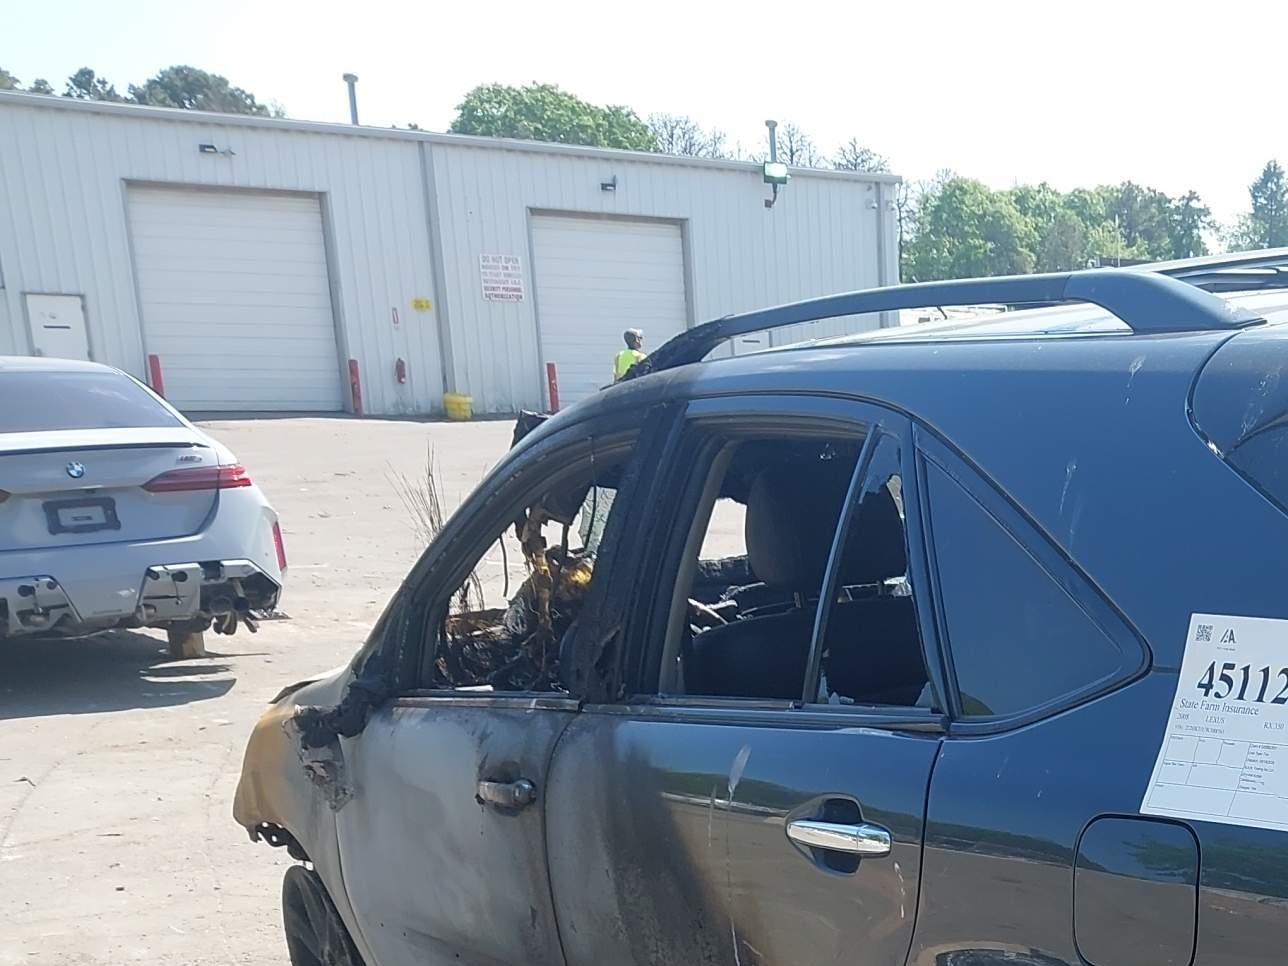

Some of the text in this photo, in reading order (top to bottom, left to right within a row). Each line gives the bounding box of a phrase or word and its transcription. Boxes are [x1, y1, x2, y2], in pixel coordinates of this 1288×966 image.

[1180, 698, 1259, 716] State Farm Insurance
[1205, 715, 1225, 724] LEXUS
